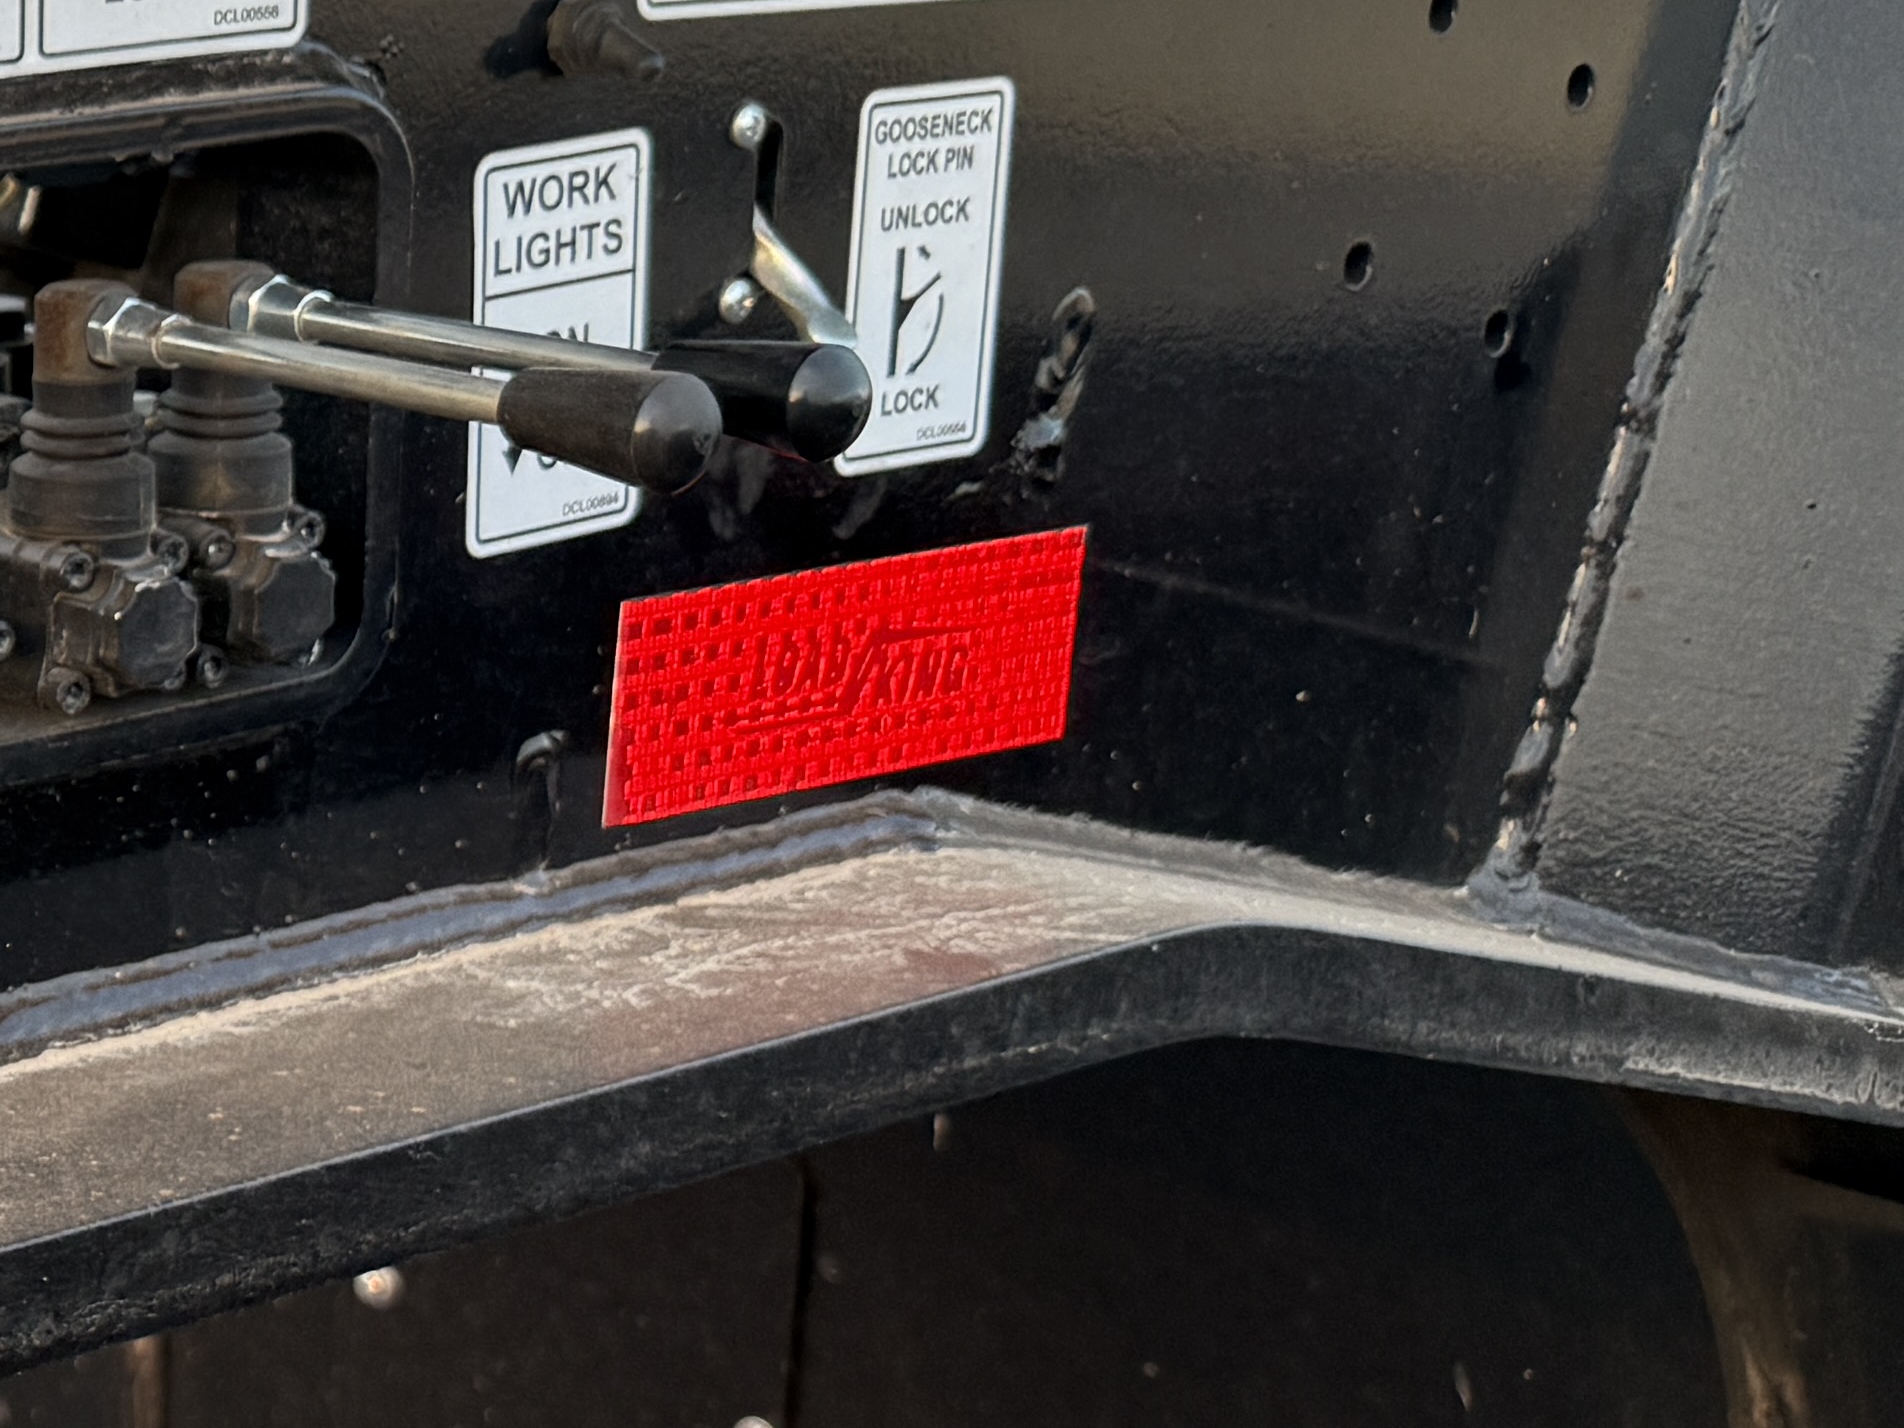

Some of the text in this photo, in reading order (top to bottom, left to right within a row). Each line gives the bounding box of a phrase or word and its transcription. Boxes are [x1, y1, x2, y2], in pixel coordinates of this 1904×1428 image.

[874, 108, 993, 145] GOOSENECK
[886, 145, 974, 180] LOCK PIN
[503, 164, 618, 219] WORK
[880, 198, 971, 232] UNLOCK
[493, 218, 623, 277] LIGHTS
[880, 387, 940, 417] LOCK
